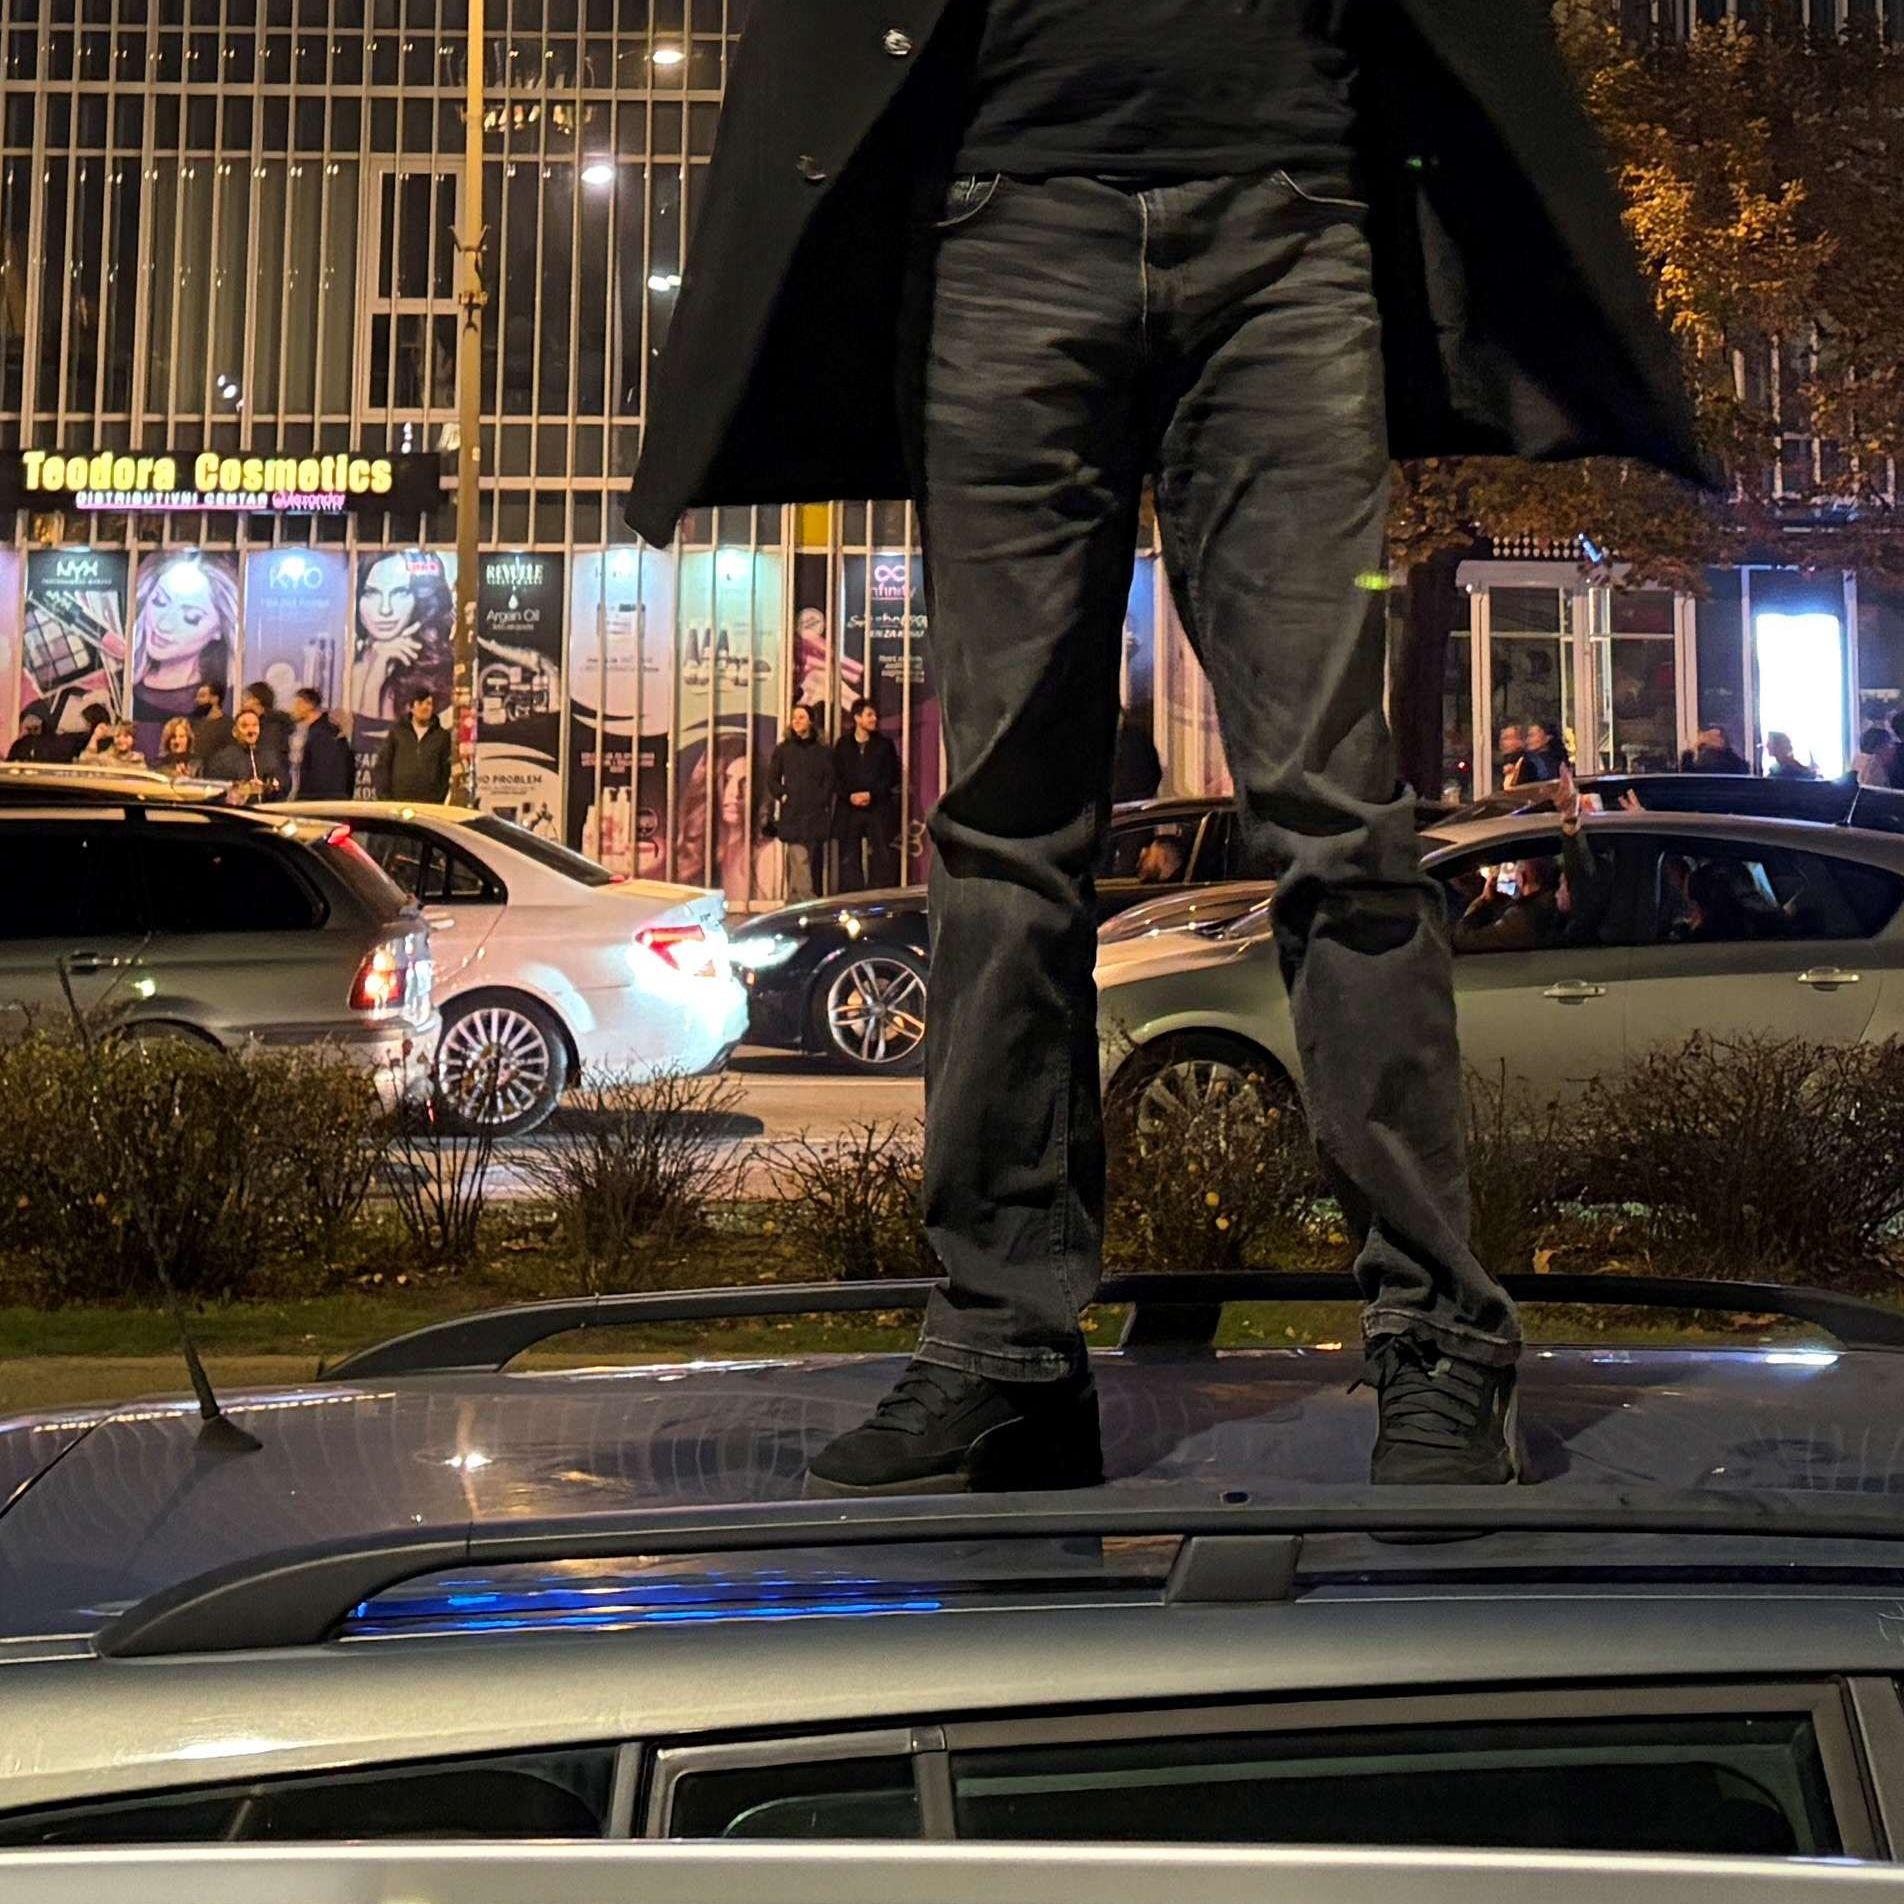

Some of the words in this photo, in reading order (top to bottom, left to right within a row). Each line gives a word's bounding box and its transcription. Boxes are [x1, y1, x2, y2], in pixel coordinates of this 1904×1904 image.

[22, 450, 176, 491] Teodora
[195, 451, 393, 493] Cosmetics
[57, 560, 98, 583] NYX
